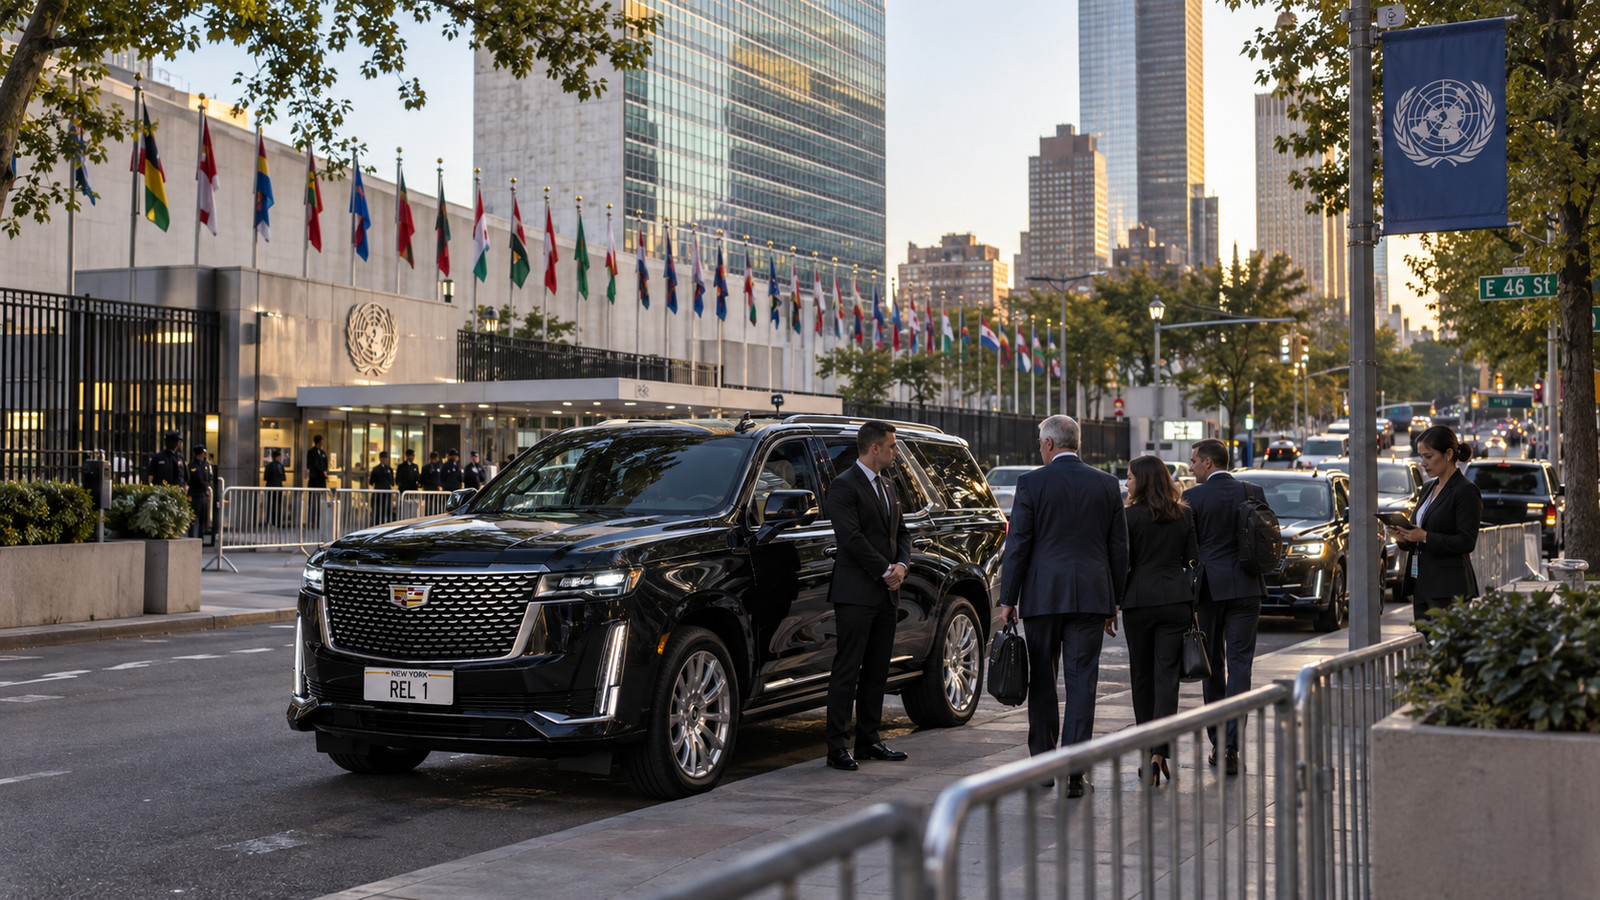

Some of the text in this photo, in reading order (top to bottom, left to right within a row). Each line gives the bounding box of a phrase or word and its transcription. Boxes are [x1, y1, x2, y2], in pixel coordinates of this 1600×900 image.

[1486, 277, 1551, 297] E 46 St
[390, 680, 428, 699] REL 1
